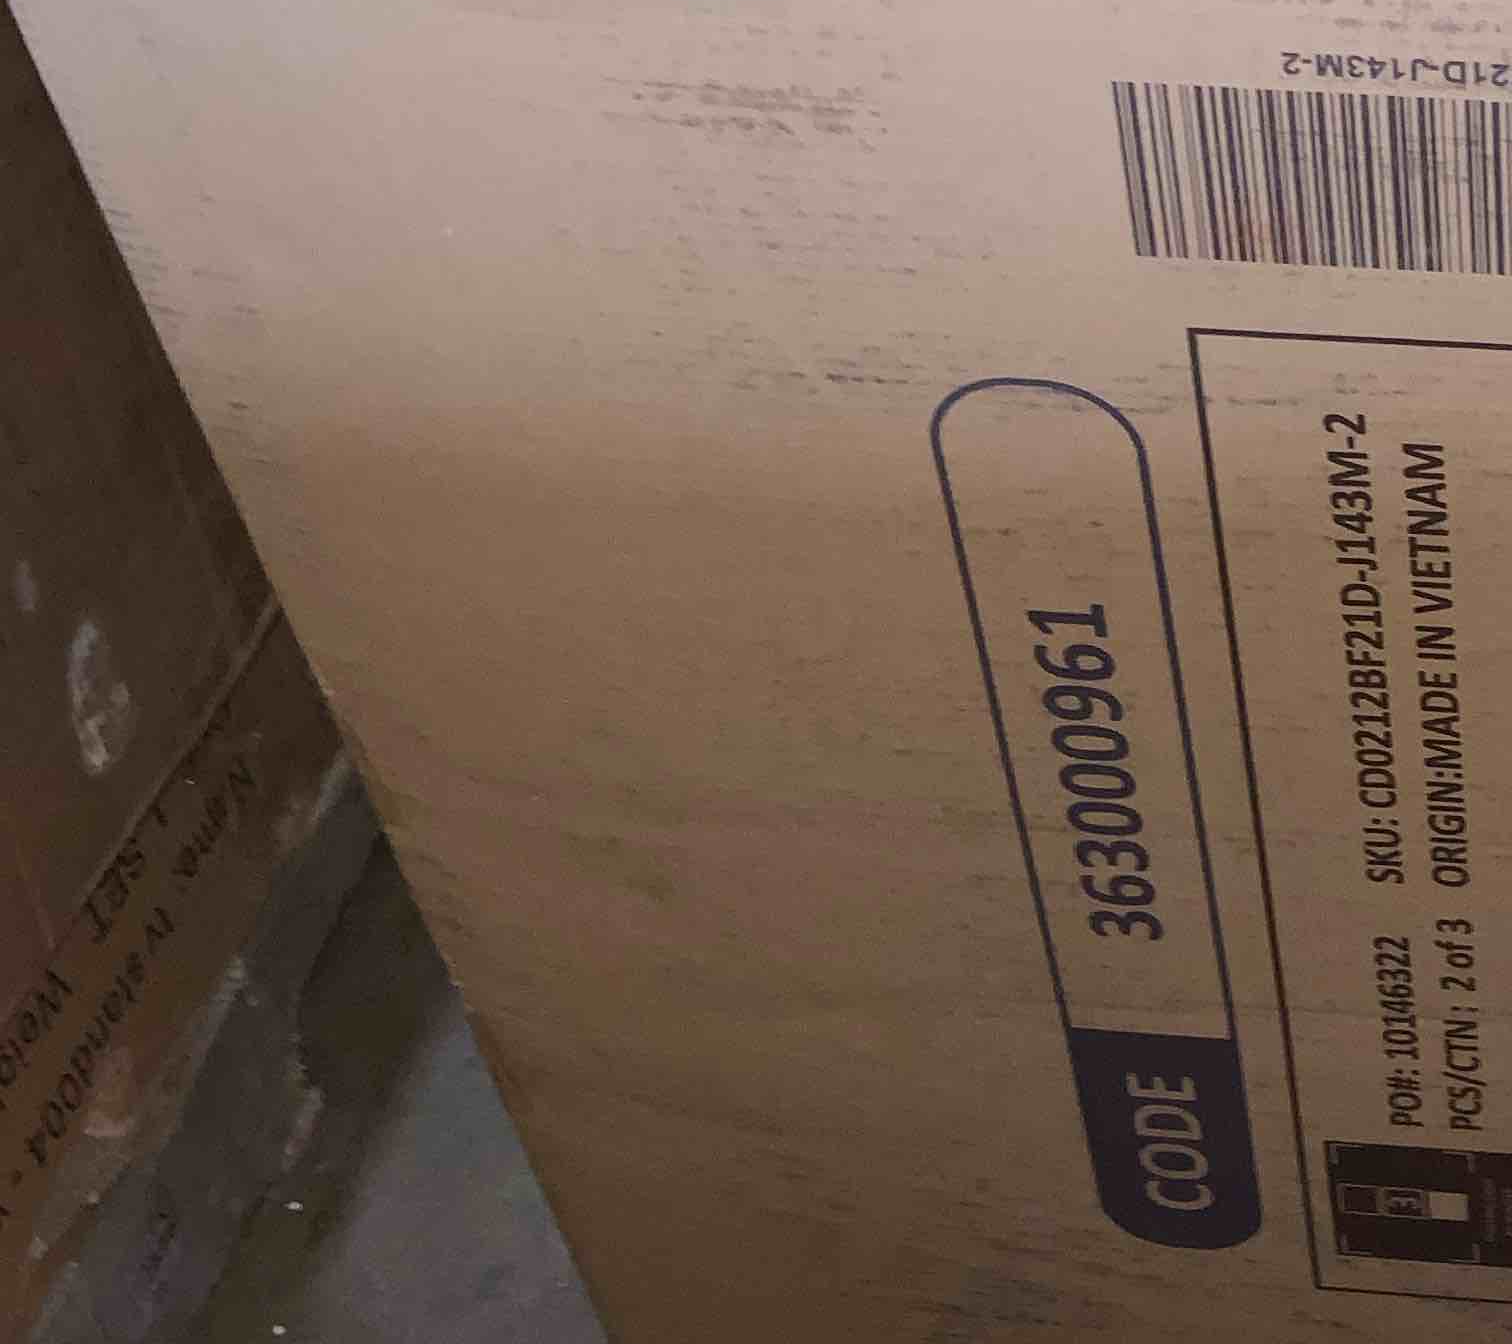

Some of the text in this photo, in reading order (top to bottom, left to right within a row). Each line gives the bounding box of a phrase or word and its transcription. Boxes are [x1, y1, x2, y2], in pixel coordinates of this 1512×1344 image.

[1322, 411, 1405, 885] SKU: CD0212BF21D-J143M-2
[1402, 442, 1470, 889] ORIGIN:MADE IN VIETNAM
[1027, 601, 1164, 943] 363000961
[1434, 938, 1475, 969] of
[1435, 917, 1474, 936] 3
[1439, 975, 1477, 992] 2
[1373, 935, 1424, 1127] PO#: 10146322
[1126, 1072, 1214, 1214] CODE
